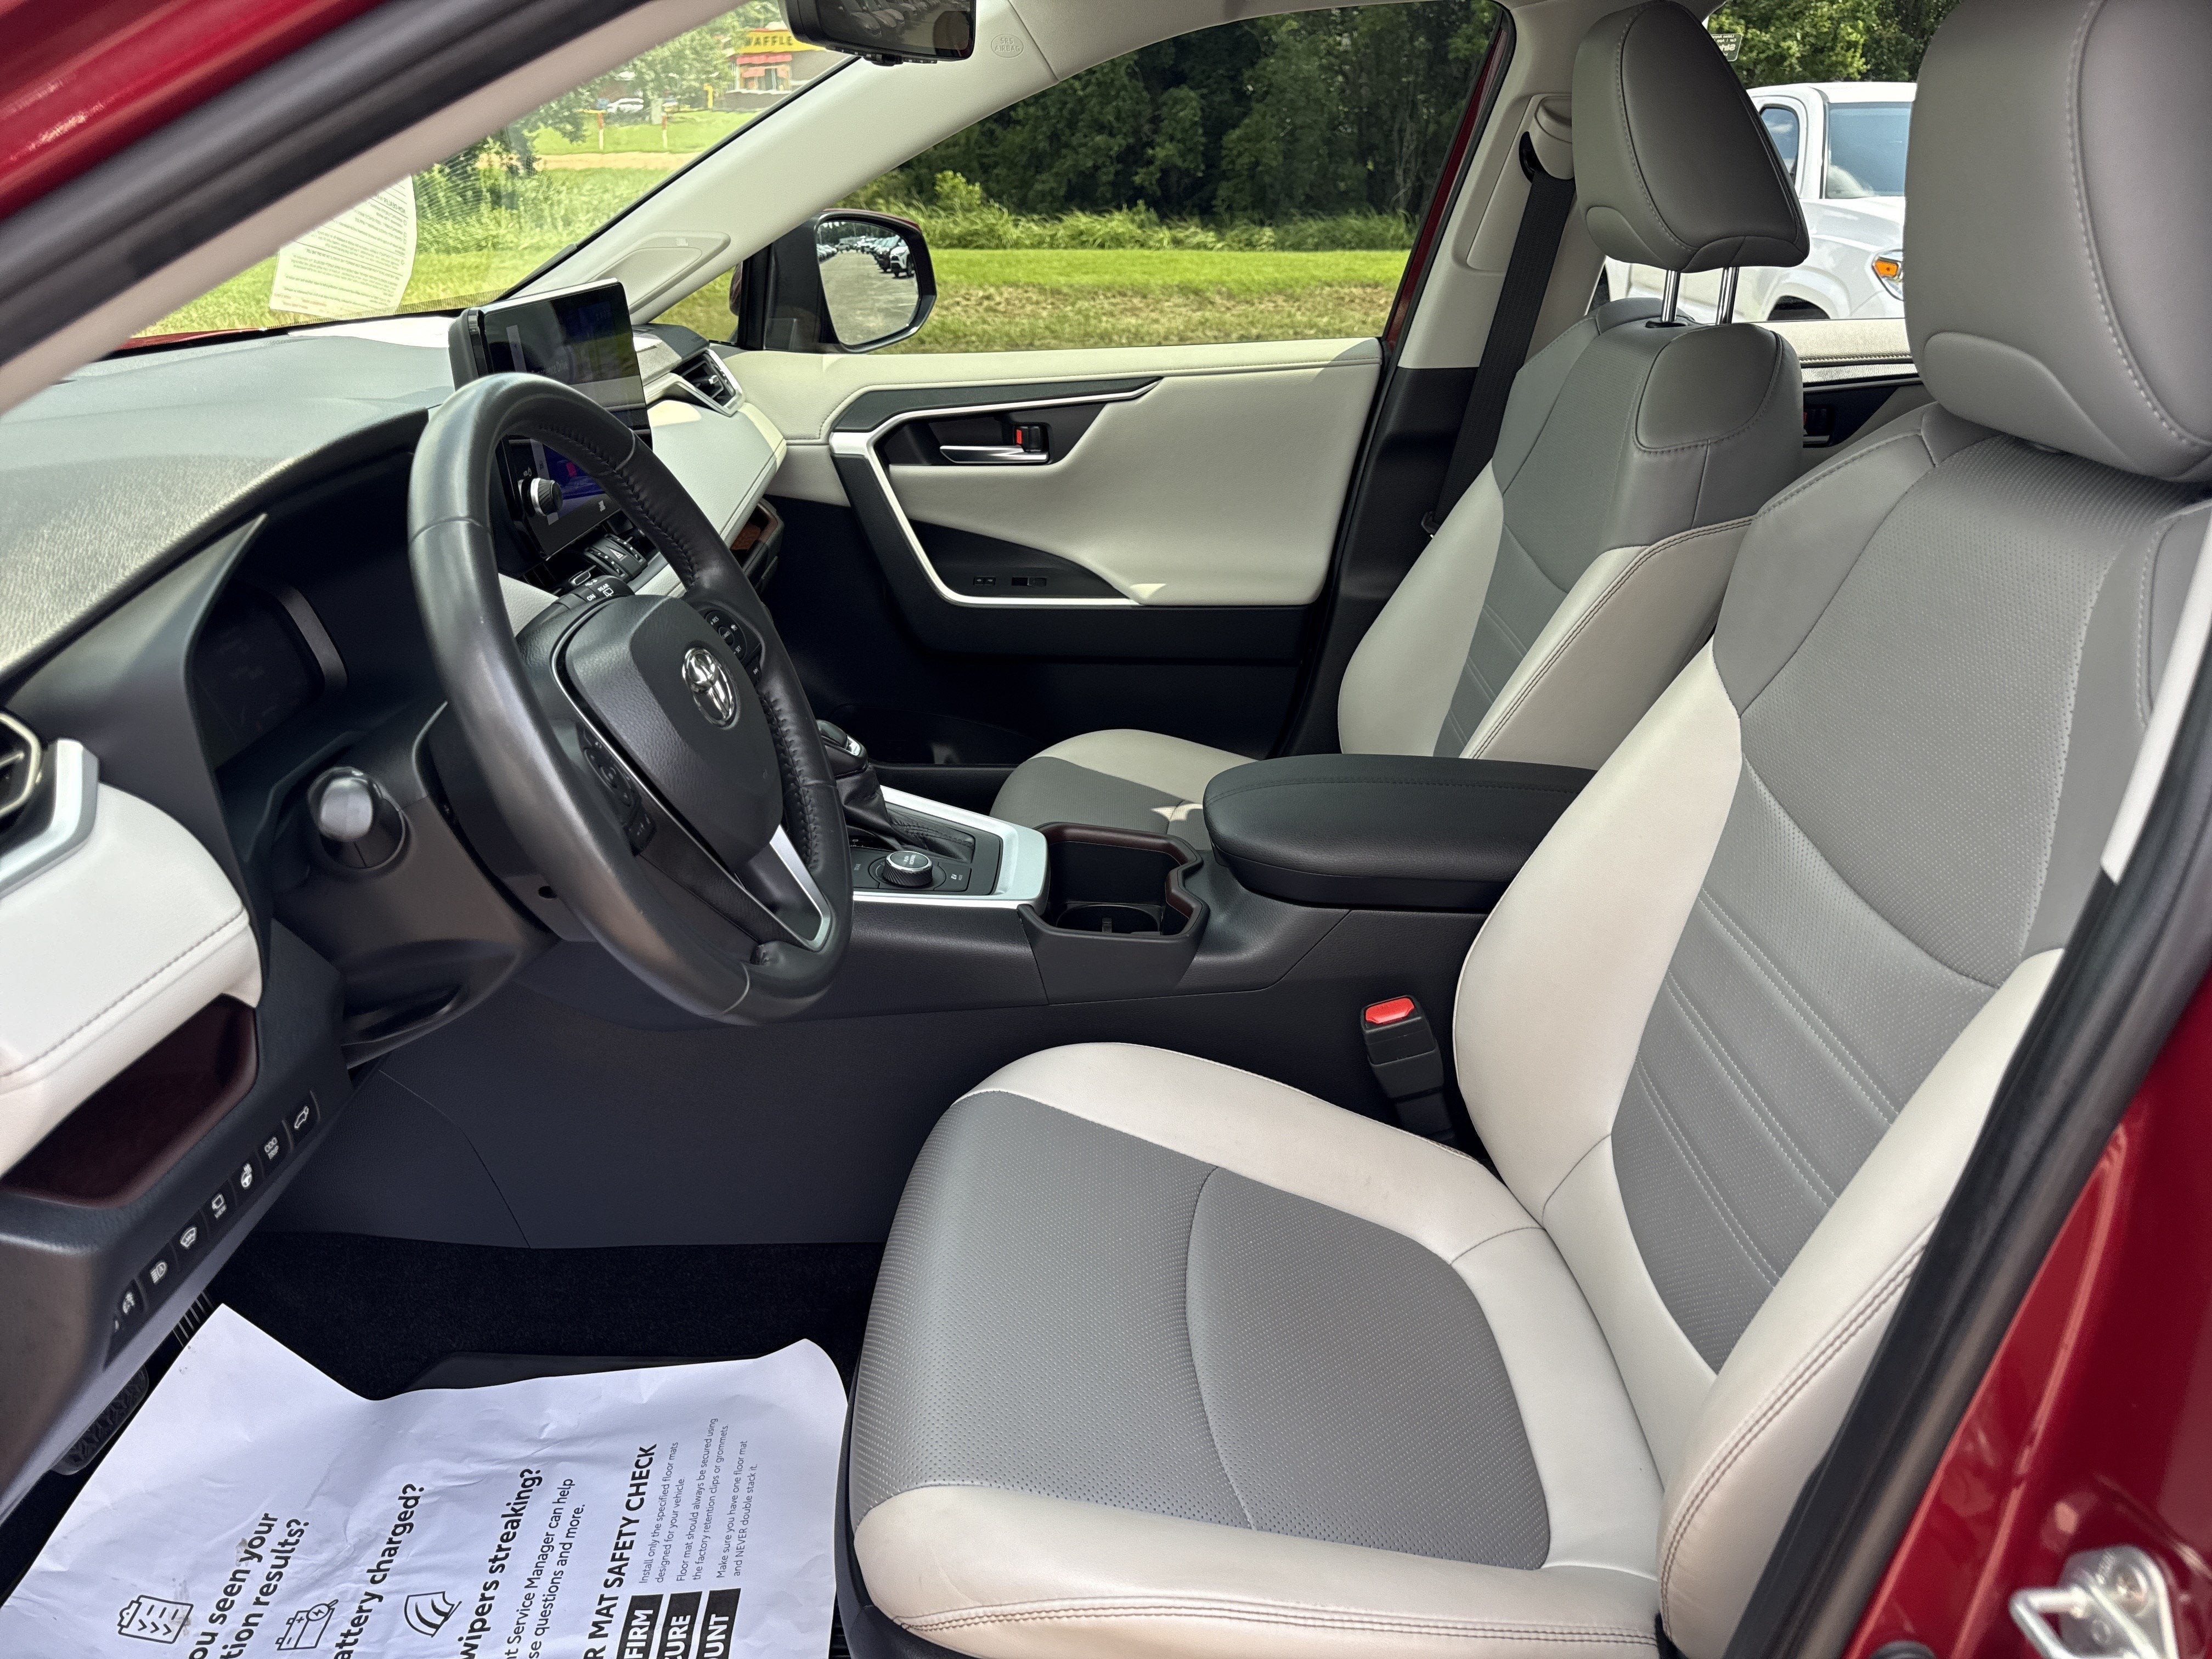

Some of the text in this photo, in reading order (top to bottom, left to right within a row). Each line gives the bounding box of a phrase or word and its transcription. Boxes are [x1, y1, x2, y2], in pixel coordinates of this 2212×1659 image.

[597, 583, 610, 592] REAR
[552, 1479, 575, 1504] help
[625, 1443, 657, 1511] CHECK
[709, 1474, 720, 1494] clips
[714, 1465, 721, 1474] or
[747, 1472, 757, 1493] stack
[549, 1508, 564, 1528] can
[639, 1442, 679, 1583] Install only the specified floor mats
[676, 1418, 719, 1582] Floor mat should always be secured using
[704, 1495, 716, 1533] retention
[716, 1440, 748, 1578] Make sure you have one floor mat
[740, 1496, 753, 1526] double
[458, 1469, 543, 1659] wipers streaking?
[524, 1532, 555, 1589] Manager
[603, 1516, 640, 1588] SAFETY
[655, 1543, 672, 1583] designed
[664, 1528, 674, 1543] for
[669, 1510, 679, 1529] your
[695, 1535, 711, 1564] factory
[735, 1528, 748, 1558] NEVER
[208, 1570, 251, 1625] seen
[239, 1513, 278, 1562] your
[220, 1519, 309, 1659] tion results?
[334, 1483, 425, 1659] attery charged?
[534, 1570, 564, 1637] questions
[557, 1542, 573, 1566] and
[566, 1504, 585, 1538] more.
[692, 1565, 702, 1580] the
[734, 1560, 743, 1576] and
[507, 1592, 535, 1644] Service
[588, 1594, 619, 1639] MAT
[624, 1610, 653, 1659] FIRM
[664, 1615, 691, 1659] URE
[704, 1613, 729, 1659] UNT
